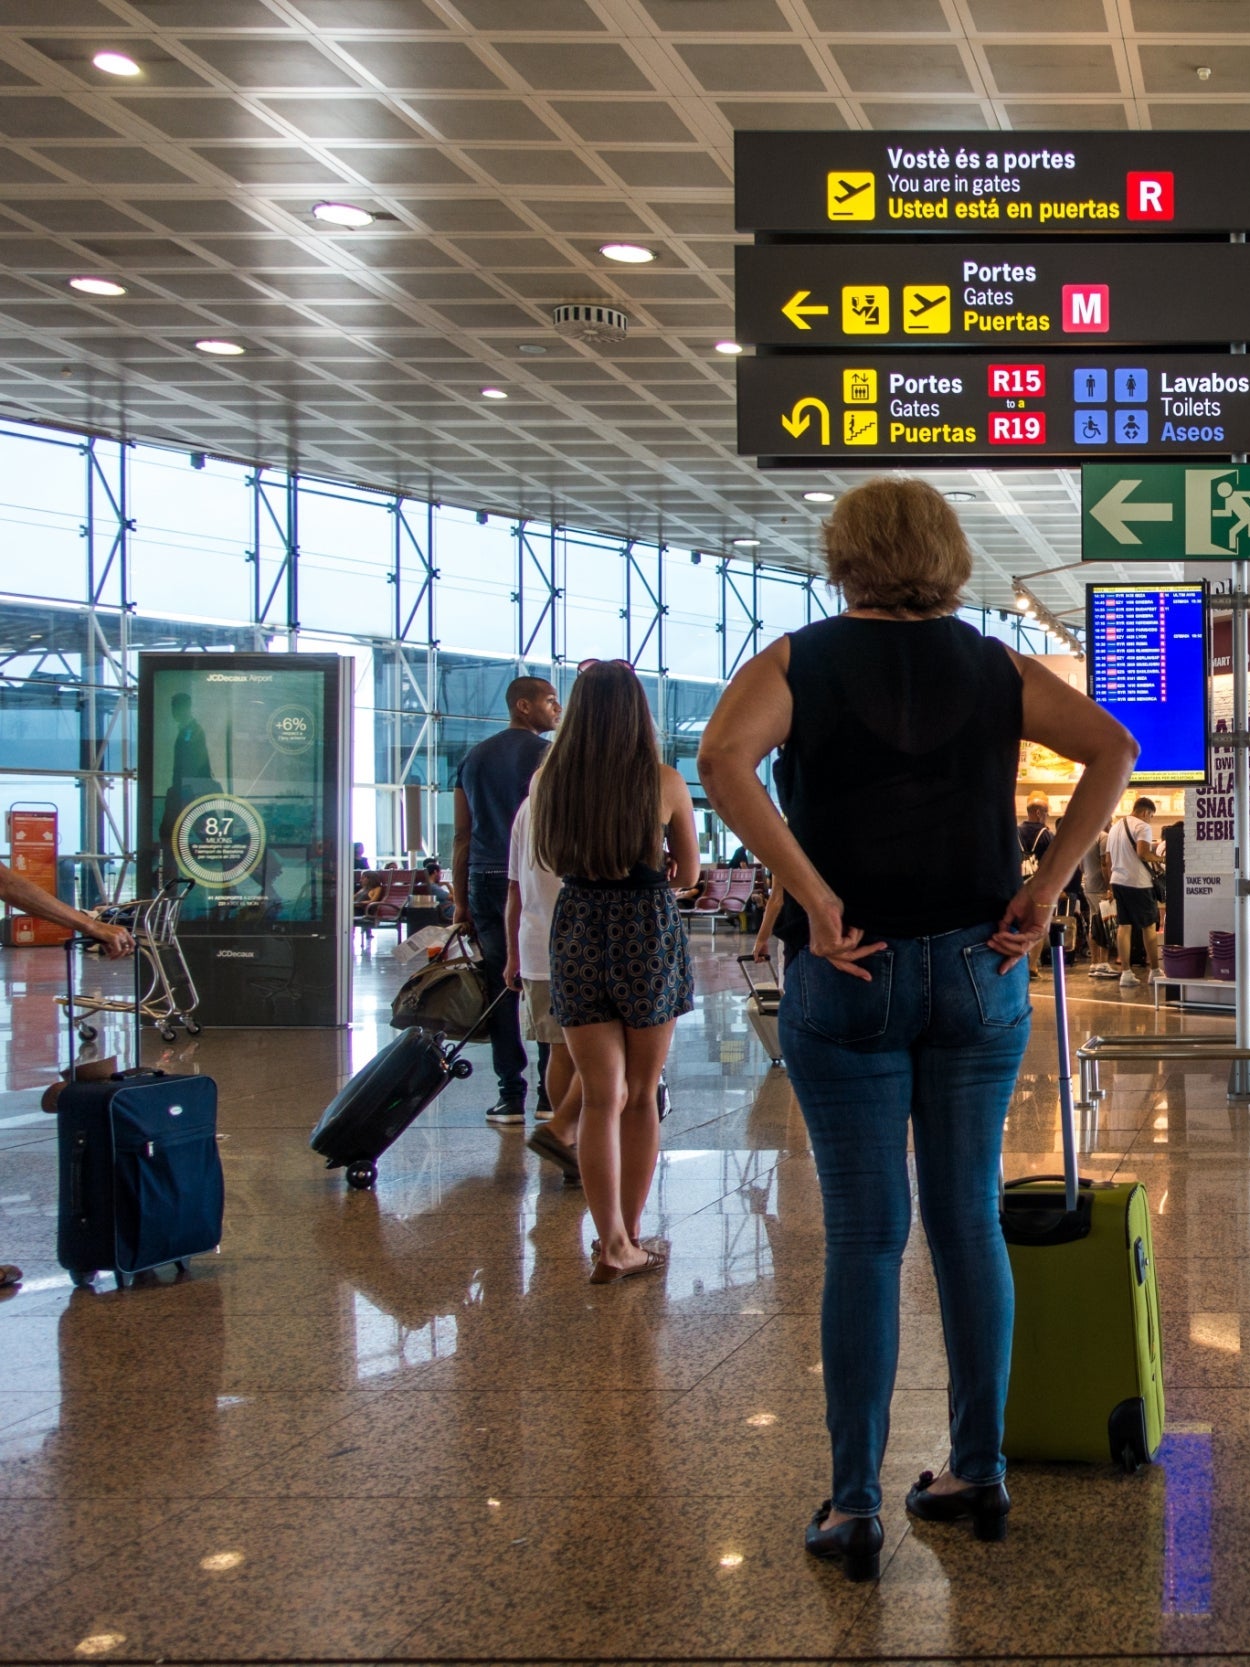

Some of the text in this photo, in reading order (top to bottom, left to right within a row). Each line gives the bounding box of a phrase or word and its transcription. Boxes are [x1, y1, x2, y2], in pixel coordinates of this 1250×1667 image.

[888, 149, 1075, 173] Vostè és a portes
[888, 175, 1020, 195] You are in gates
[1139, 181, 1162, 212] R
[889, 198, 1119, 222] Usted está en puertas
[964, 262, 1036, 281] Portes
[964, 288, 1013, 305] Gates
[1072, 294, 1102, 324] M
[964, 311, 1049, 331] Puertas
[890, 374, 962, 393] Portes
[993, 370, 1040, 392] R15
[1162, 373, 1249, 392] Lavabos
[891, 399, 939, 417] Gates
[1007, 400, 1024, 408] to a
[1161, 398, 1220, 416] Toilets
[891, 423, 976, 442] Puertas
[994, 418, 1040, 439] R19
[1162, 422, 1224, 441] Aseos
[207, 674, 272, 684] JCDecaux Airport
[275, 718, 307, 731] +6%
[205, 818, 232, 837] 8,7
[216, 949, 254, 959] JCDecaux
